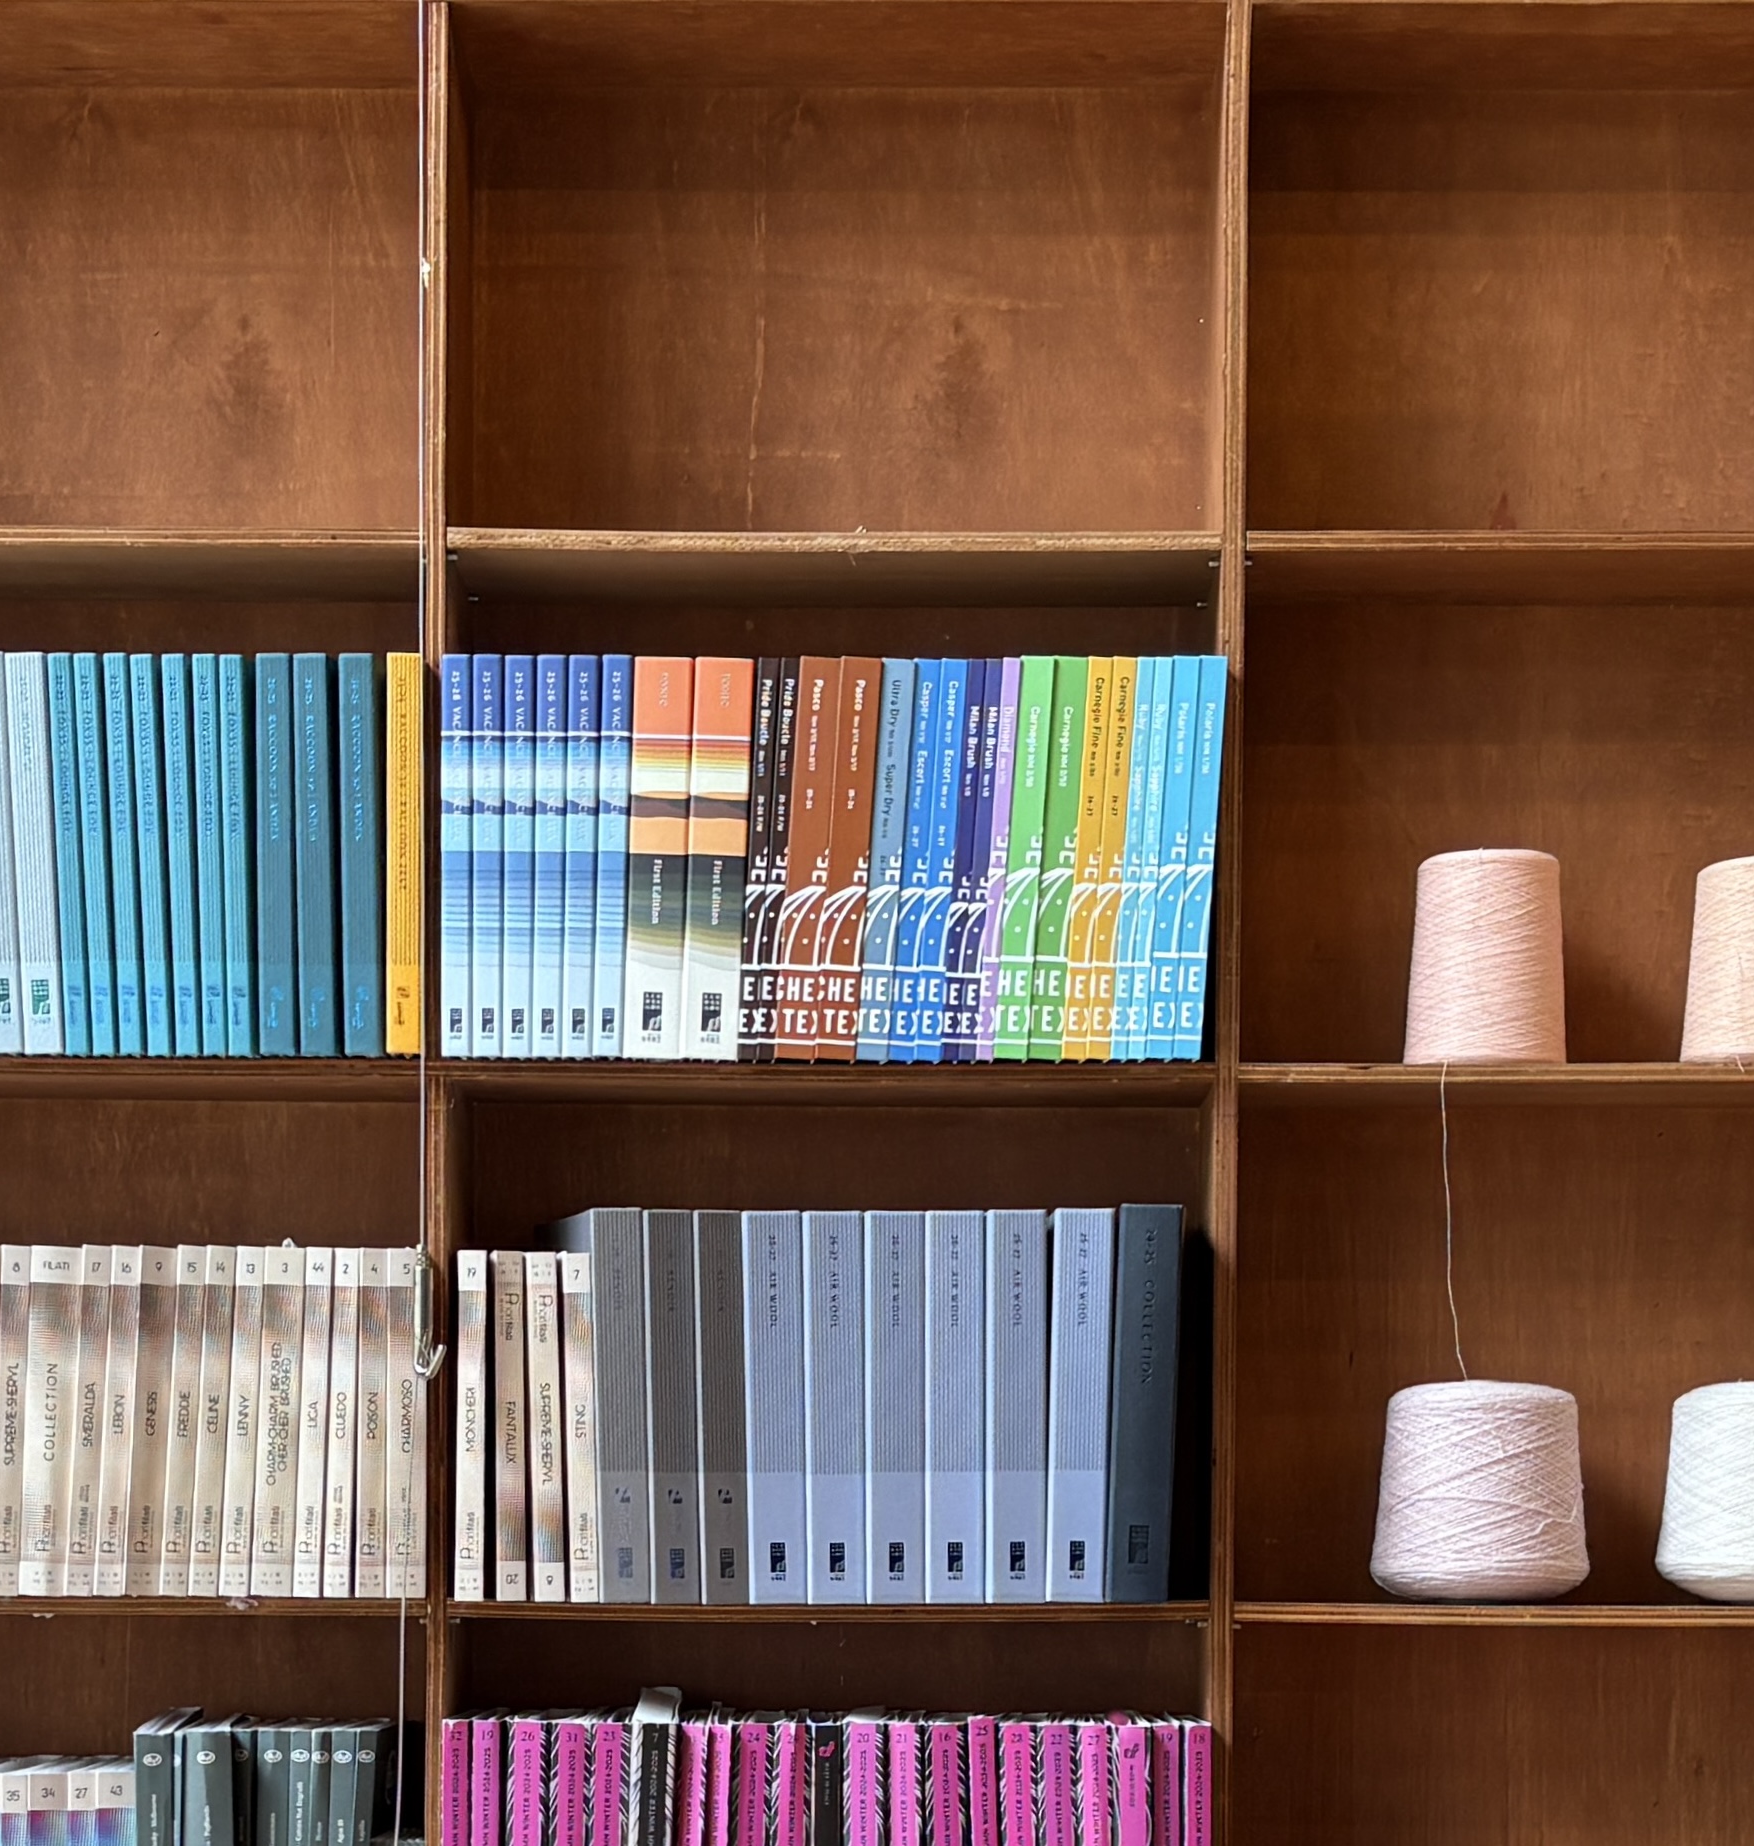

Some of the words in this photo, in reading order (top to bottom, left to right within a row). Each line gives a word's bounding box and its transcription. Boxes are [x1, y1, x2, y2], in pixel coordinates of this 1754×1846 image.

[759, 678, 773, 707] Pride
[811, 678, 825, 712] Pasco
[889, 679, 903, 706] Ultra
[916, 681, 932, 718] Casper
[944, 680, 959, 717] Casper
[884, 707, 900, 728] Dry
[967, 705, 981, 735] Milan
[1000, 705, 1014, 753] Diamond
[1174, 702, 1189, 741] Polaris
[964, 735, 978, 769] Brush
[1090, 725, 1103, 749] Fine
[881, 763, 897, 795] Super
[914, 749, 929, 784] Escort
[941, 748, 955, 784] Escort
[879, 796, 895, 816] Dry
[651, 858, 663, 883] First
[710, 859, 723, 885] First
[650, 884, 663, 925] Edition
[709, 886, 723, 926] Edition
[281, 1262, 289, 1273] 3
[1077, 1268, 1088, 1289] AIR
[1077, 1291, 1089, 1328] WOOL
[1139, 1279, 1157, 1385] COLLECTION
[42, 1362, 57, 1462] COLLECTION
[574, 1404, 588, 1439] STING
[41, 1787, 56, 1798] 34
[451, 1796, 460, 1832] WINTER
